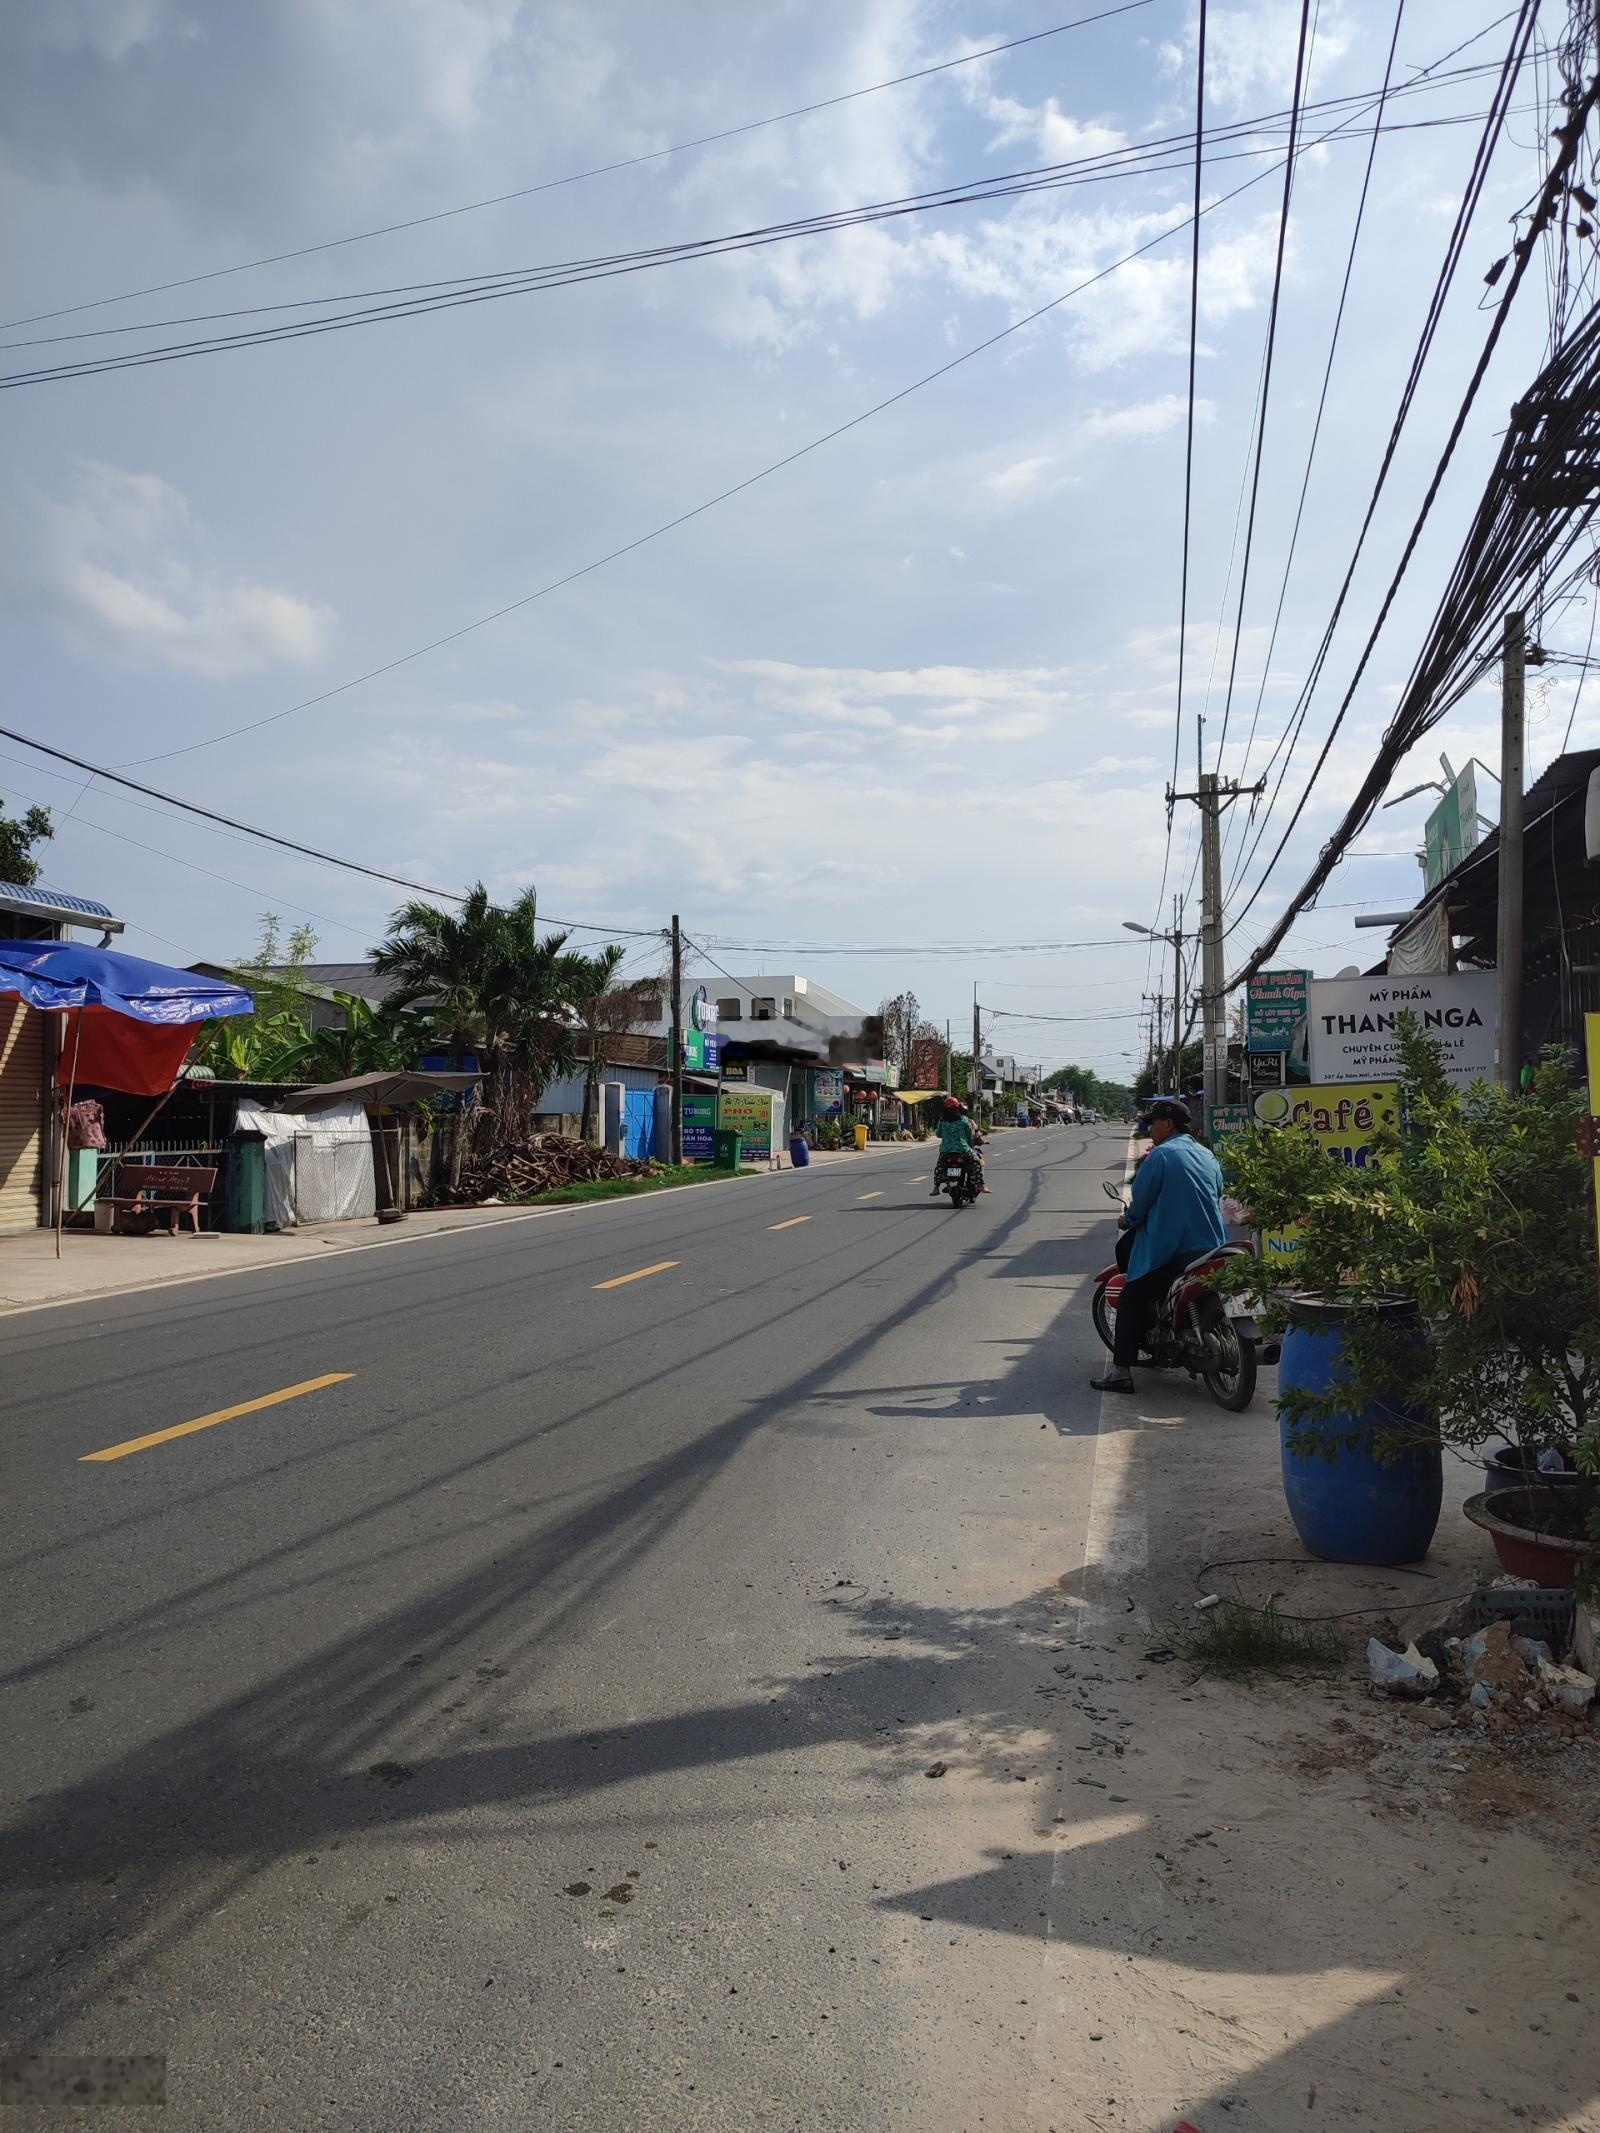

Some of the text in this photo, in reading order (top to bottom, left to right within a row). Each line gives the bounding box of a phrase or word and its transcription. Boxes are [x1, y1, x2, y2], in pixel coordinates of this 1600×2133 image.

[1369, 984, 1432, 1002] MỸ PHẨM
[1321, 1007, 1484, 1035] THAN NGA
[1343, 1043, 1381, 1053] CHUYÊN
[1353, 1055, 1367, 1065] MỸ
[684, 1107, 711, 1116] TUBORG
[1292, 1097, 1376, 1133] Café
